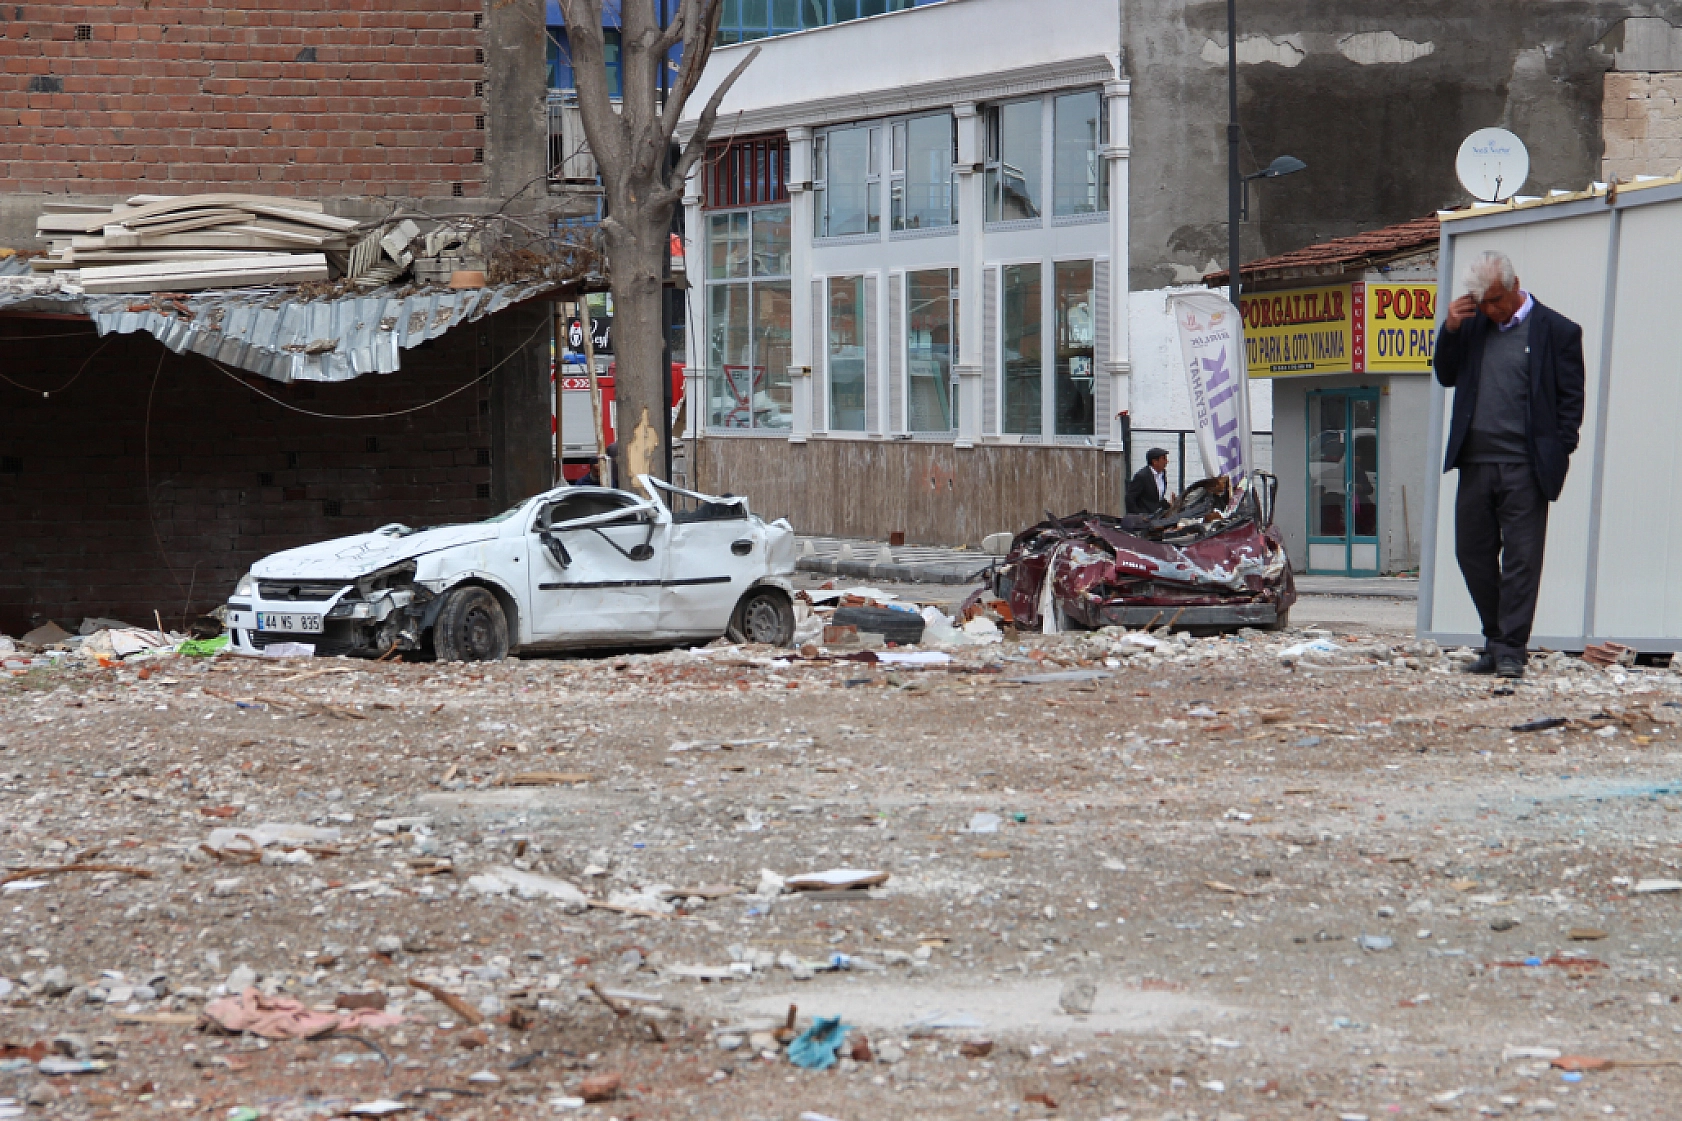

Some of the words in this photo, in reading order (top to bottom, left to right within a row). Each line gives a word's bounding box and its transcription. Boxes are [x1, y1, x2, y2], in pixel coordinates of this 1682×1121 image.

[1240, 290, 1345, 329] PORGALILAR
[1375, 288, 1437, 320] POR
[1244, 337, 1258, 364] TO
[1260, 336, 1282, 363] PARK
[1284, 335, 1290, 361] &
[1293, 333, 1309, 361] OTO
[1311, 330, 1345, 360] YIKAMA
[1378, 328, 1405, 357] OTO
[265, 615, 277, 629] 44
[301, 615, 320, 629] 835
